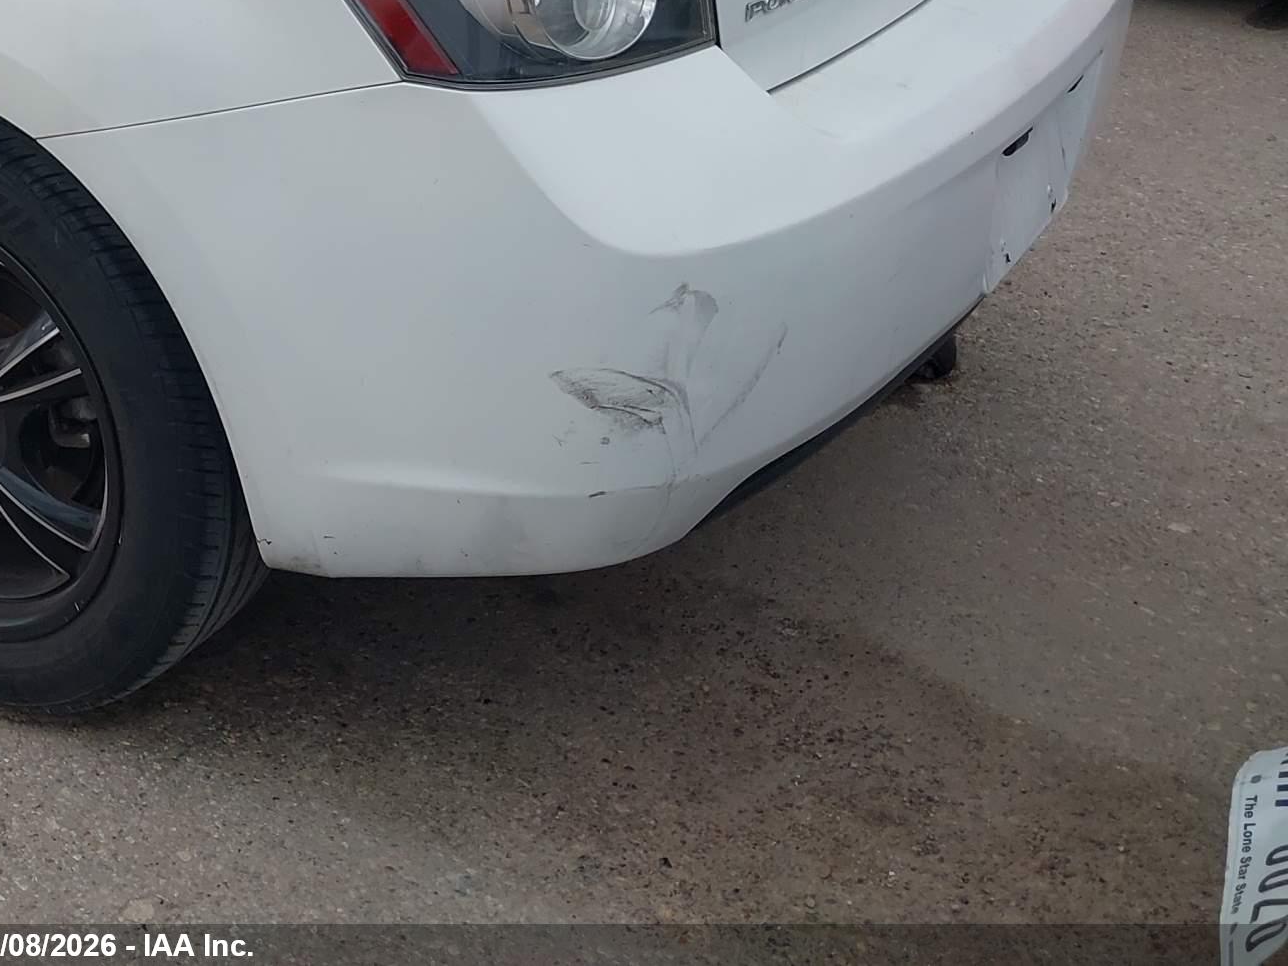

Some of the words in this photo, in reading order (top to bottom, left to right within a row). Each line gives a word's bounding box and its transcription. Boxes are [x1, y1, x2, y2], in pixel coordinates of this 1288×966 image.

[1244, 795, 1258, 818] The
[1242, 823, 1256, 853] Lone
[1238, 855, 1253, 880] Star
[1231, 882, 1247, 915] State
